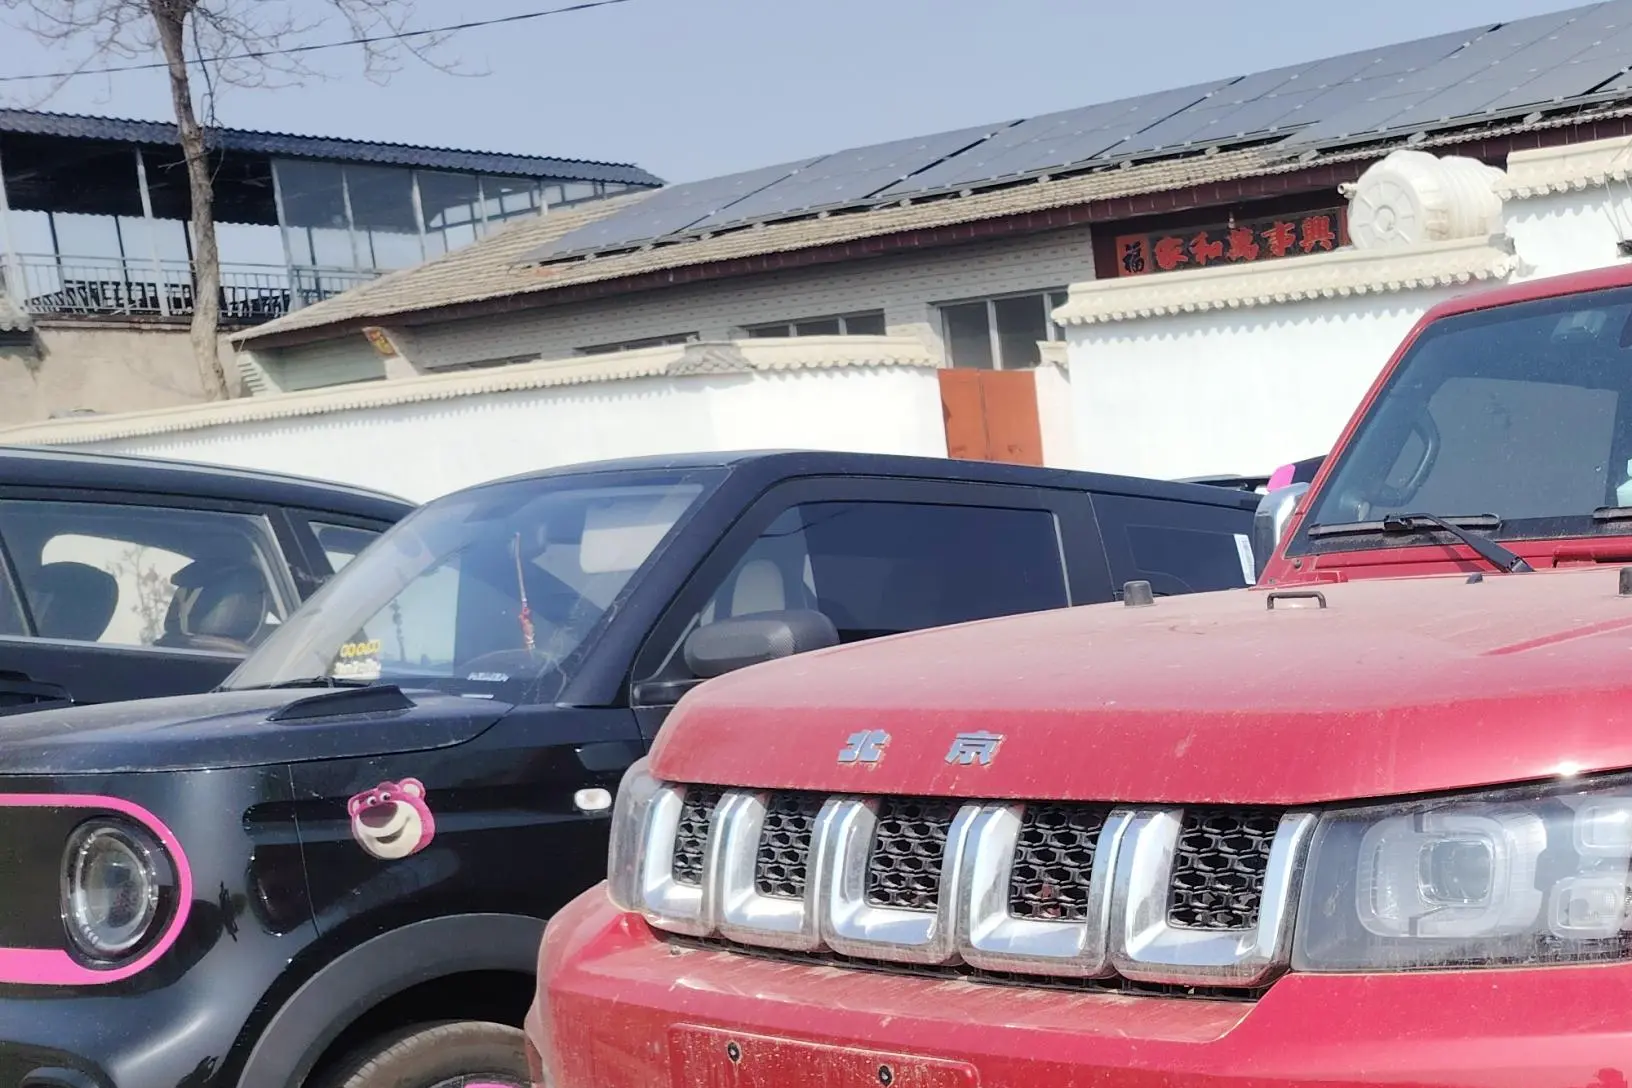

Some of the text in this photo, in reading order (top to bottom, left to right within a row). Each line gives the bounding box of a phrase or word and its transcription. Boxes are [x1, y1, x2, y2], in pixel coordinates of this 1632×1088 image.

[1122, 241, 1146, 274] 福
[1154, 215, 1336, 270] 家和萬事興
[837, 729, 1005, 766] 北京
